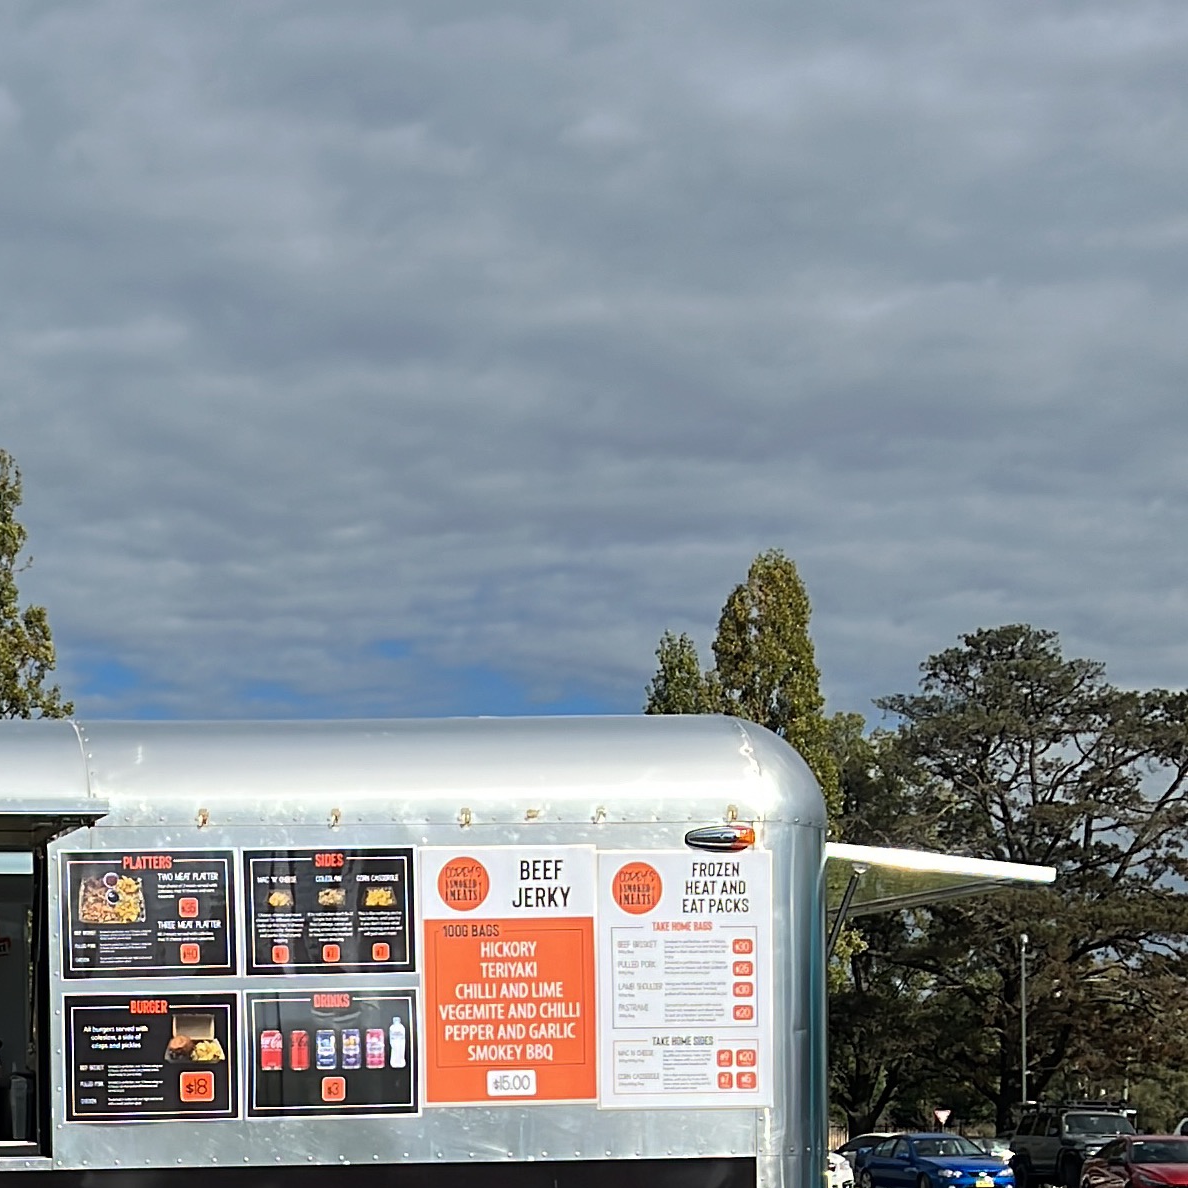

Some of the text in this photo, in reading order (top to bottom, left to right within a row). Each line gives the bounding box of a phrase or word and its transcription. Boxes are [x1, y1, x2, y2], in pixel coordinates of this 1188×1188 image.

[122, 856, 173, 869] PLATTERS
[315, 853, 344, 868] SIDES
[157, 873, 173, 881] TWO
[192, 872, 219, 880] PLATTER
[520, 860, 563, 880] BEEF
[692, 862, 740, 877] FROZEN
[450, 889, 478, 900] MEATS
[685, 880, 746, 896] HEAT AND
[512, 887, 571, 908] JERKY
[623, 894, 651, 905] MEATS
[682, 898, 749, 913] EAT PACKS
[157, 920, 222, 929] THREE MEAT PLATTER
[471, 924, 500, 936] BAGS
[652, 921, 713, 931] TAKE HOME BAGS
[480, 941, 537, 958] HICKORY
[480, 962, 538, 978] TERIYAKI
[455, 981, 563, 999] CHILLI AND LIME
[130, 1000, 168, 1014] BURGER
[313, 993, 350, 1008] DRINKS
[439, 1002, 580, 1020] VEGEMITE AND CHILLI
[444, 1022, 576, 1041] PEPPER AND GARLIC
[652, 1036, 713, 1046] TAKE HOME SIDES
[467, 1043, 554, 1061] SMOKEY BBQ
[185, 1078, 208, 1095] $18
[327, 1082, 340, 1095] $3
[493, 1074, 531, 1091] $15.00
